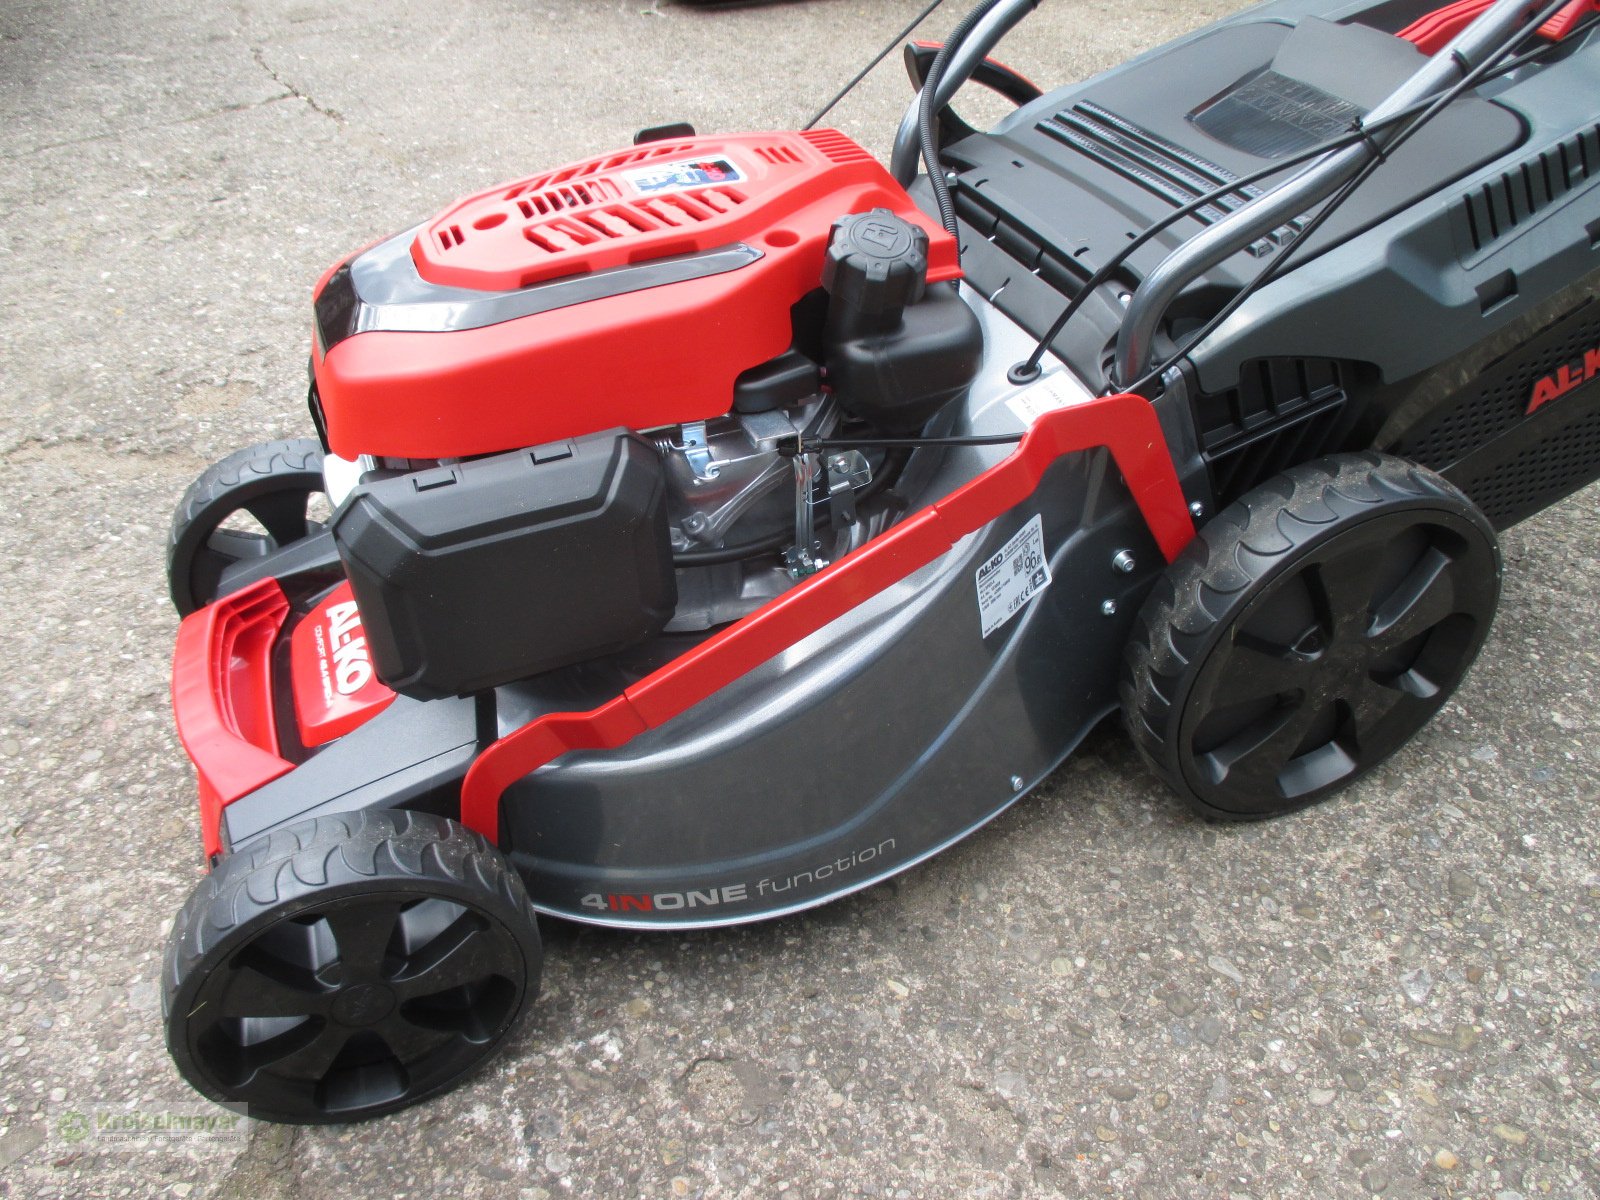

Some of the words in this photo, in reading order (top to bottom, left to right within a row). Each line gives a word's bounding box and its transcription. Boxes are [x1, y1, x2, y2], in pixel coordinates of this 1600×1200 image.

[978, 553, 1003, 580] AL-KO
[325, 600, 372, 696] AL-KO
[756, 837, 896, 896] function
